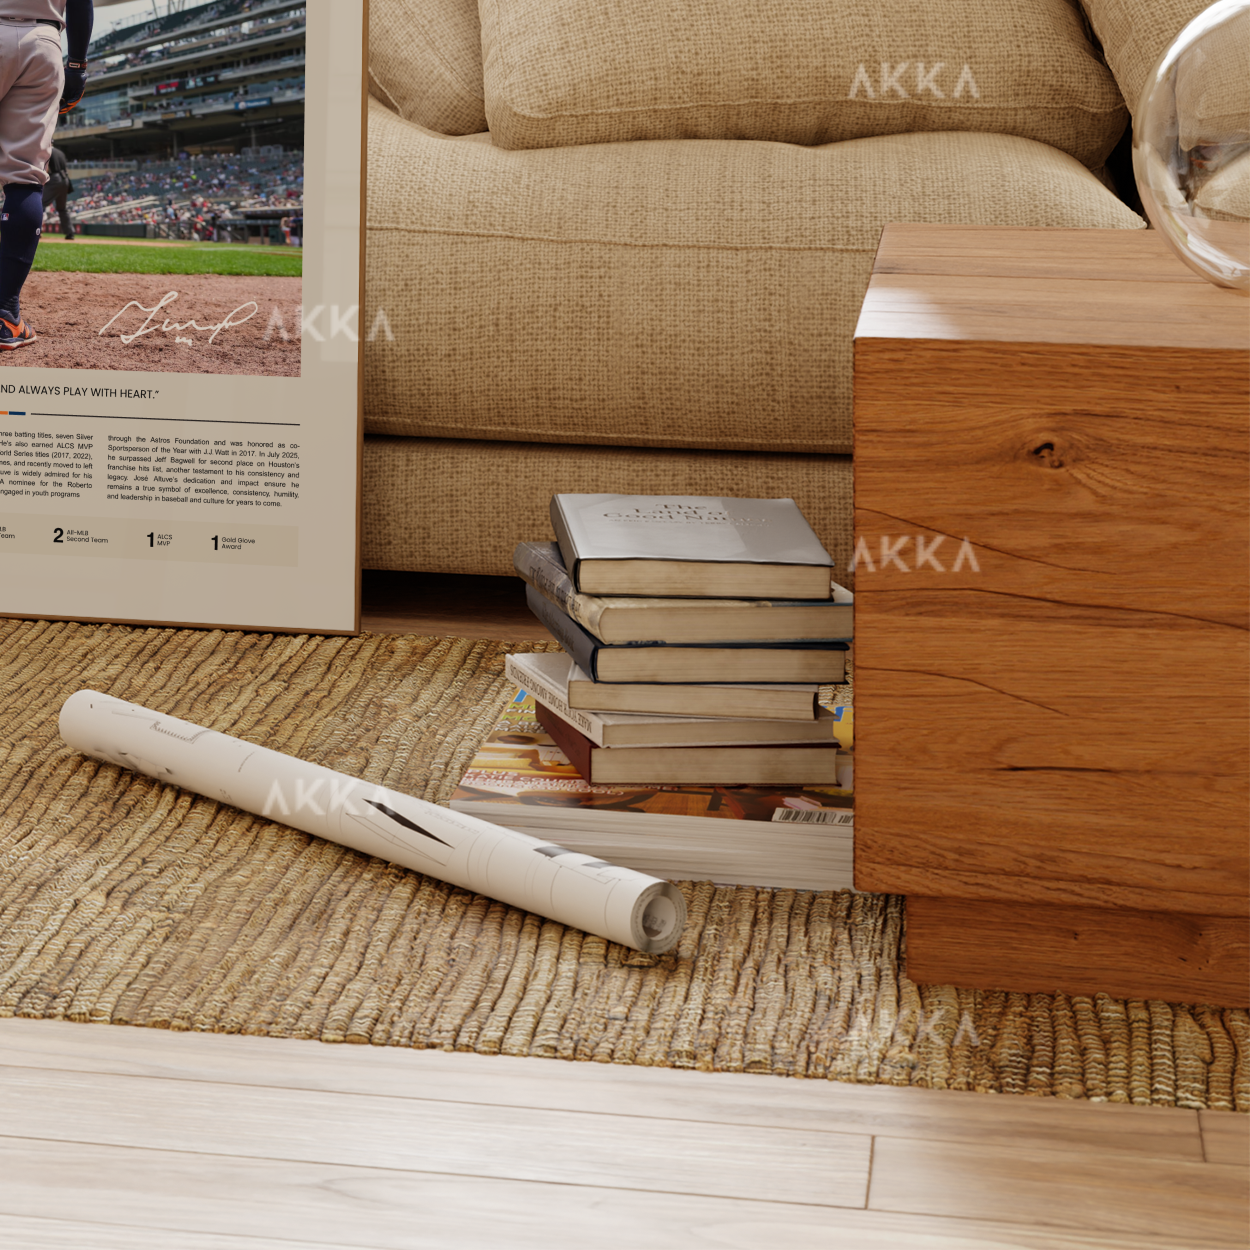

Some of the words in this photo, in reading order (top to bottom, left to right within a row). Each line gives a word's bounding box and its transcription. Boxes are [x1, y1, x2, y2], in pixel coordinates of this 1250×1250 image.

[18, 384, 61, 396] ALWAYS
[63, 386, 88, 397] PLAY
[90, 387, 117, 398] WITH
[14, 431, 36, 440] batting
[76, 433, 93, 441] Silver
[108, 435, 132, 444] through
[150, 436, 170, 444] Astros
[174, 437, 210, 446] Foundation
[53, 527, 64, 543] 2
[147, 532, 154, 547] 1
[211, 535, 218, 550] 1
